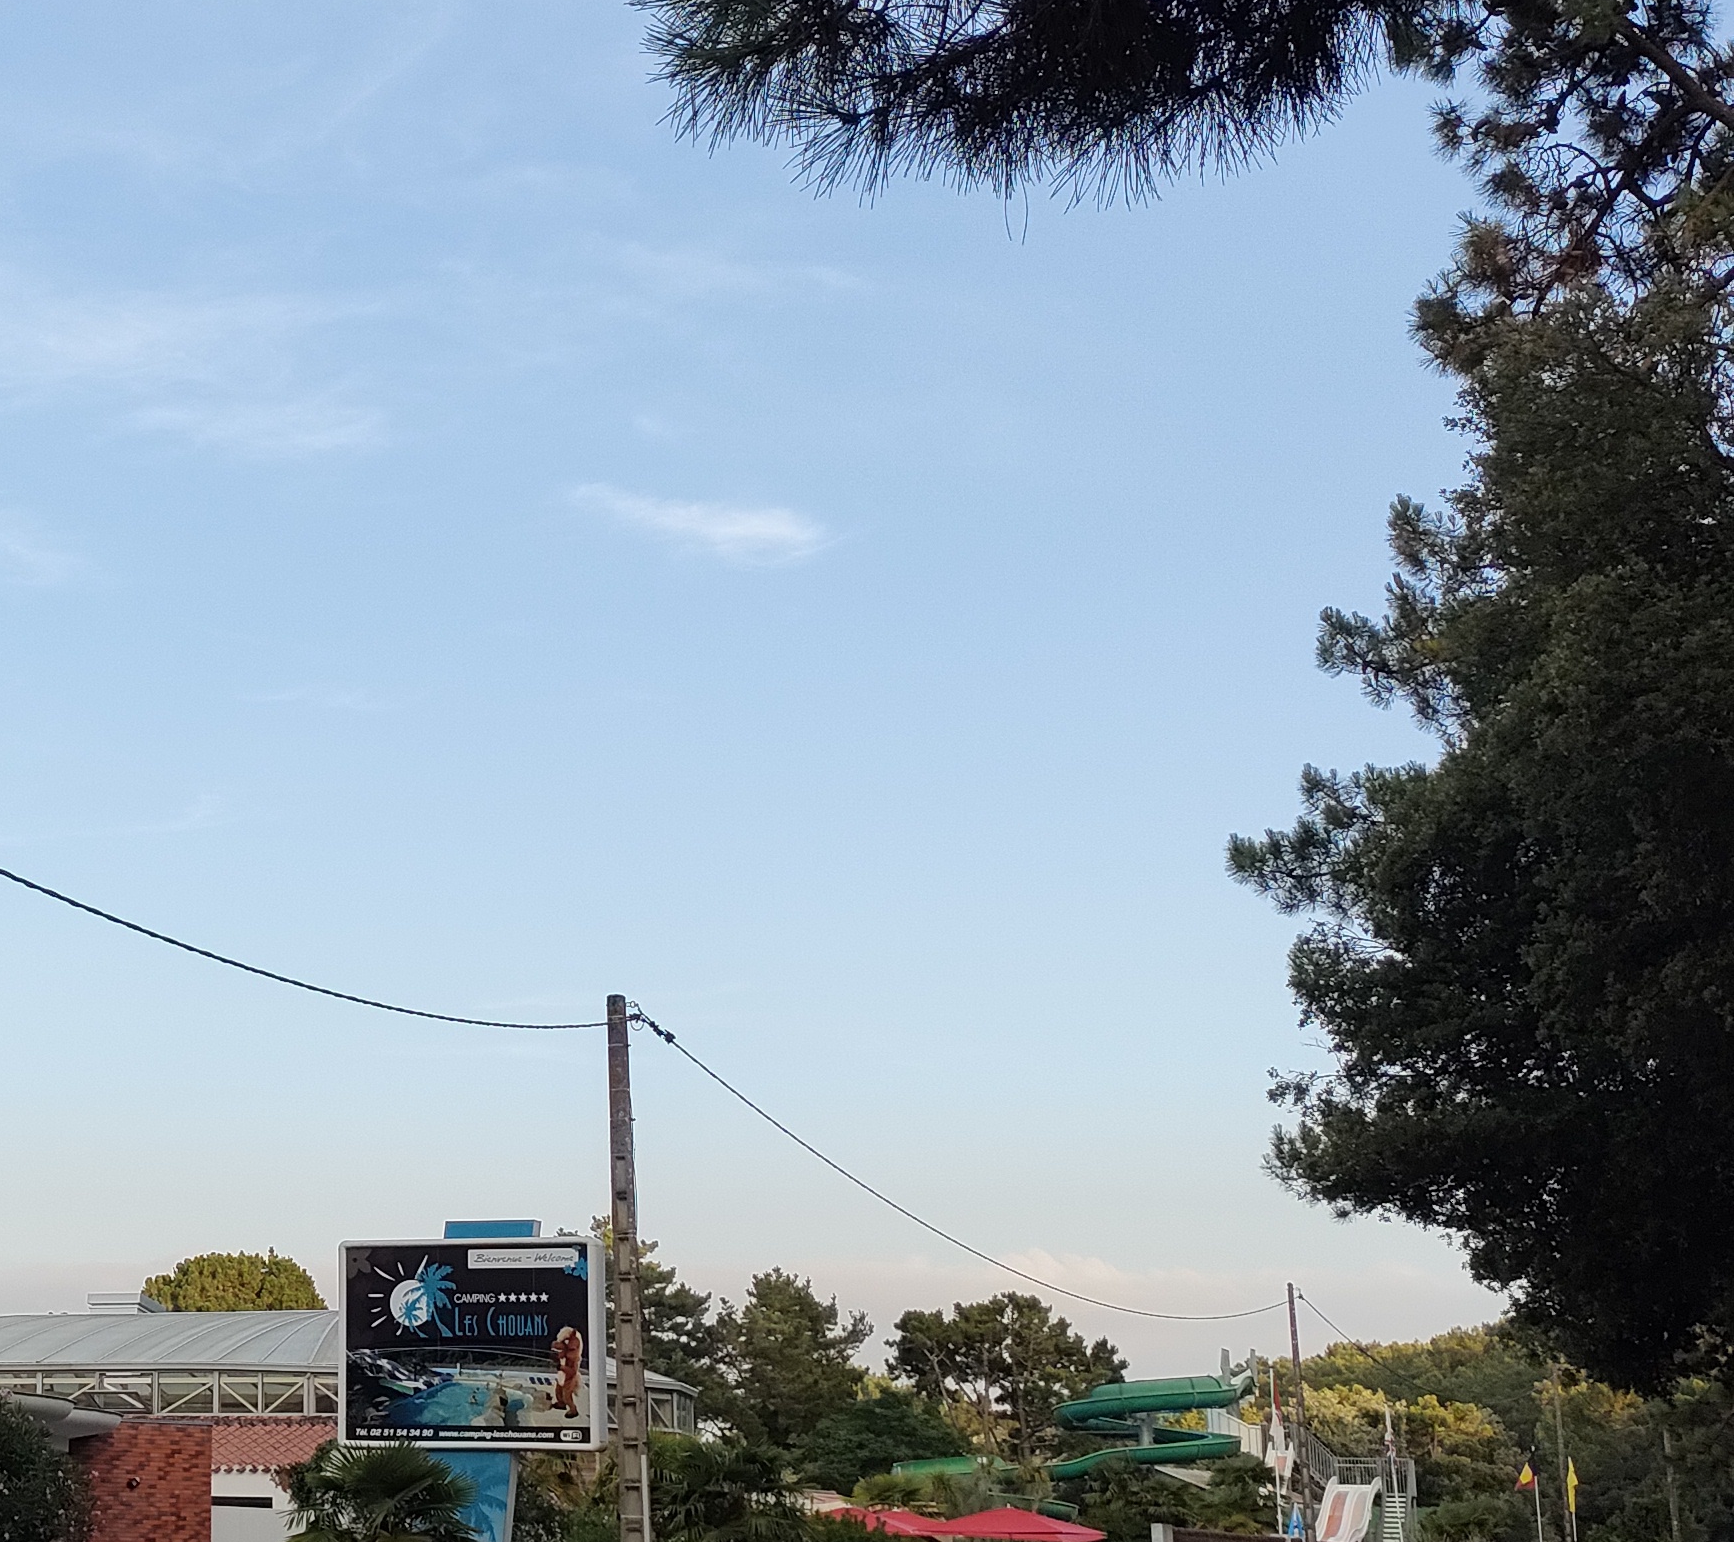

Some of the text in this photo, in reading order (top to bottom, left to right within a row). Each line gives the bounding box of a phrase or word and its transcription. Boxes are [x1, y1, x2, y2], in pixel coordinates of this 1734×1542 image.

[473, 1253, 522, 1263] Bienvenue
[533, 1252, 574, 1263] Welcome
[453, 1293, 496, 1304] CAMPING
[369, 1428, 382, 1437] 02
[383, 1428, 395, 1437] 51
[396, 1428, 407, 1437] 54
[409, 1428, 420, 1437] 34
[421, 1428, 434, 1437] 90
[438, 1429, 555, 1440] www.camping-leschouans.com
